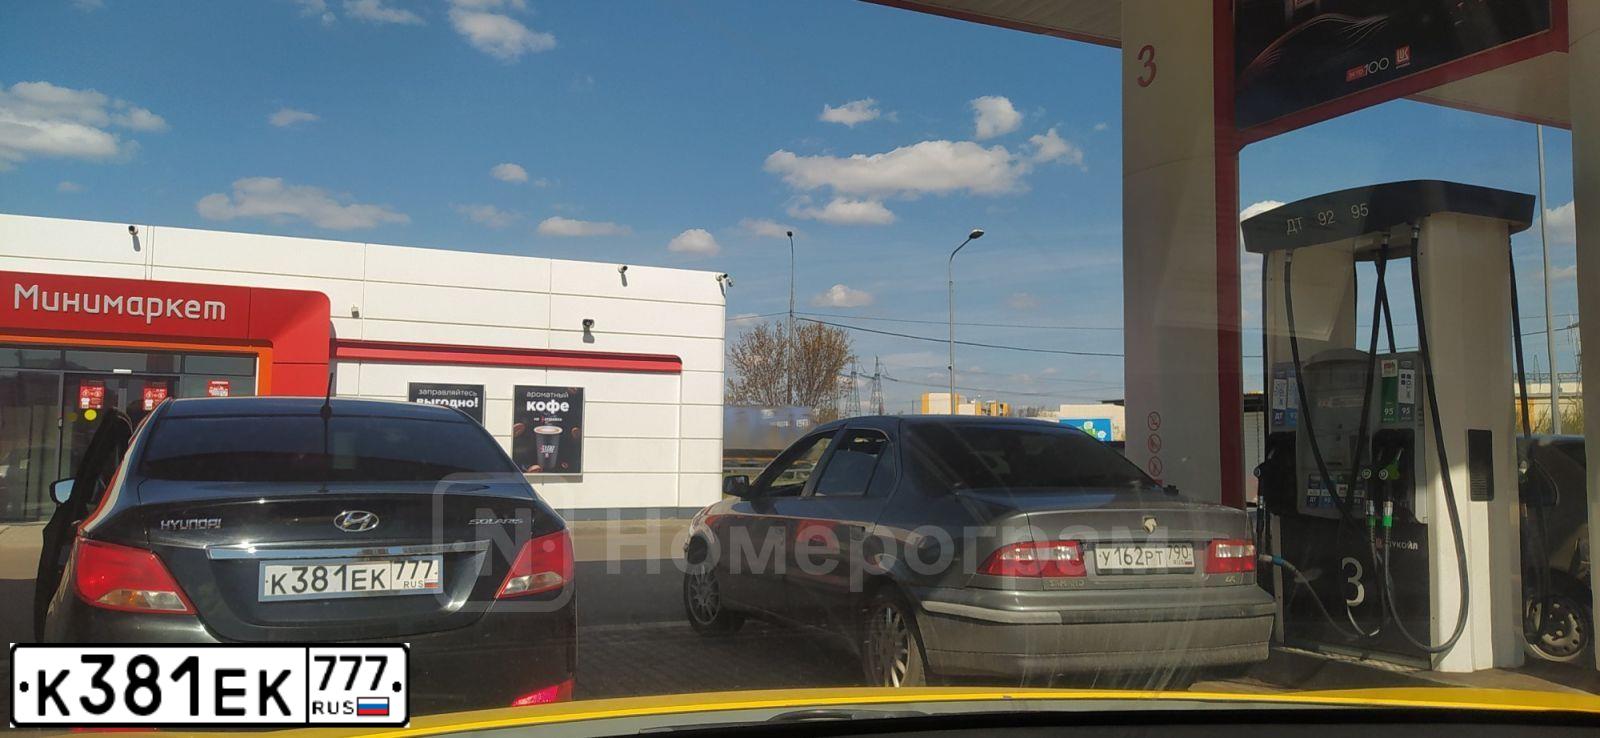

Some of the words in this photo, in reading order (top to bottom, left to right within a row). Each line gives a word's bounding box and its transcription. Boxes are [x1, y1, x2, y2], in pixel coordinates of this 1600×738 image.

[1137, 45, 1157, 87] 3
[1286, 217, 1303, 235] ДТ
[1318, 210, 1335, 226] 92
[1351, 203, 1369, 219] 95
[13, 283, 226, 324] Минимаркет
[418, 388, 478, 397] заправляйтесь
[526, 391, 569, 399] ароматный
[526, 399, 570, 414] кофе
[1384, 407, 1394, 416] 95
[1401, 407, 1411, 415] 95
[160, 518, 222, 530] HYUNDAI
[1168, 545, 1189, 562] 790
[271, 564, 386, 595] К381ЕК
[394, 559, 433, 580] 777
[403, 579, 424, 588] RUS
[1341, 557, 1365, 607] 3
